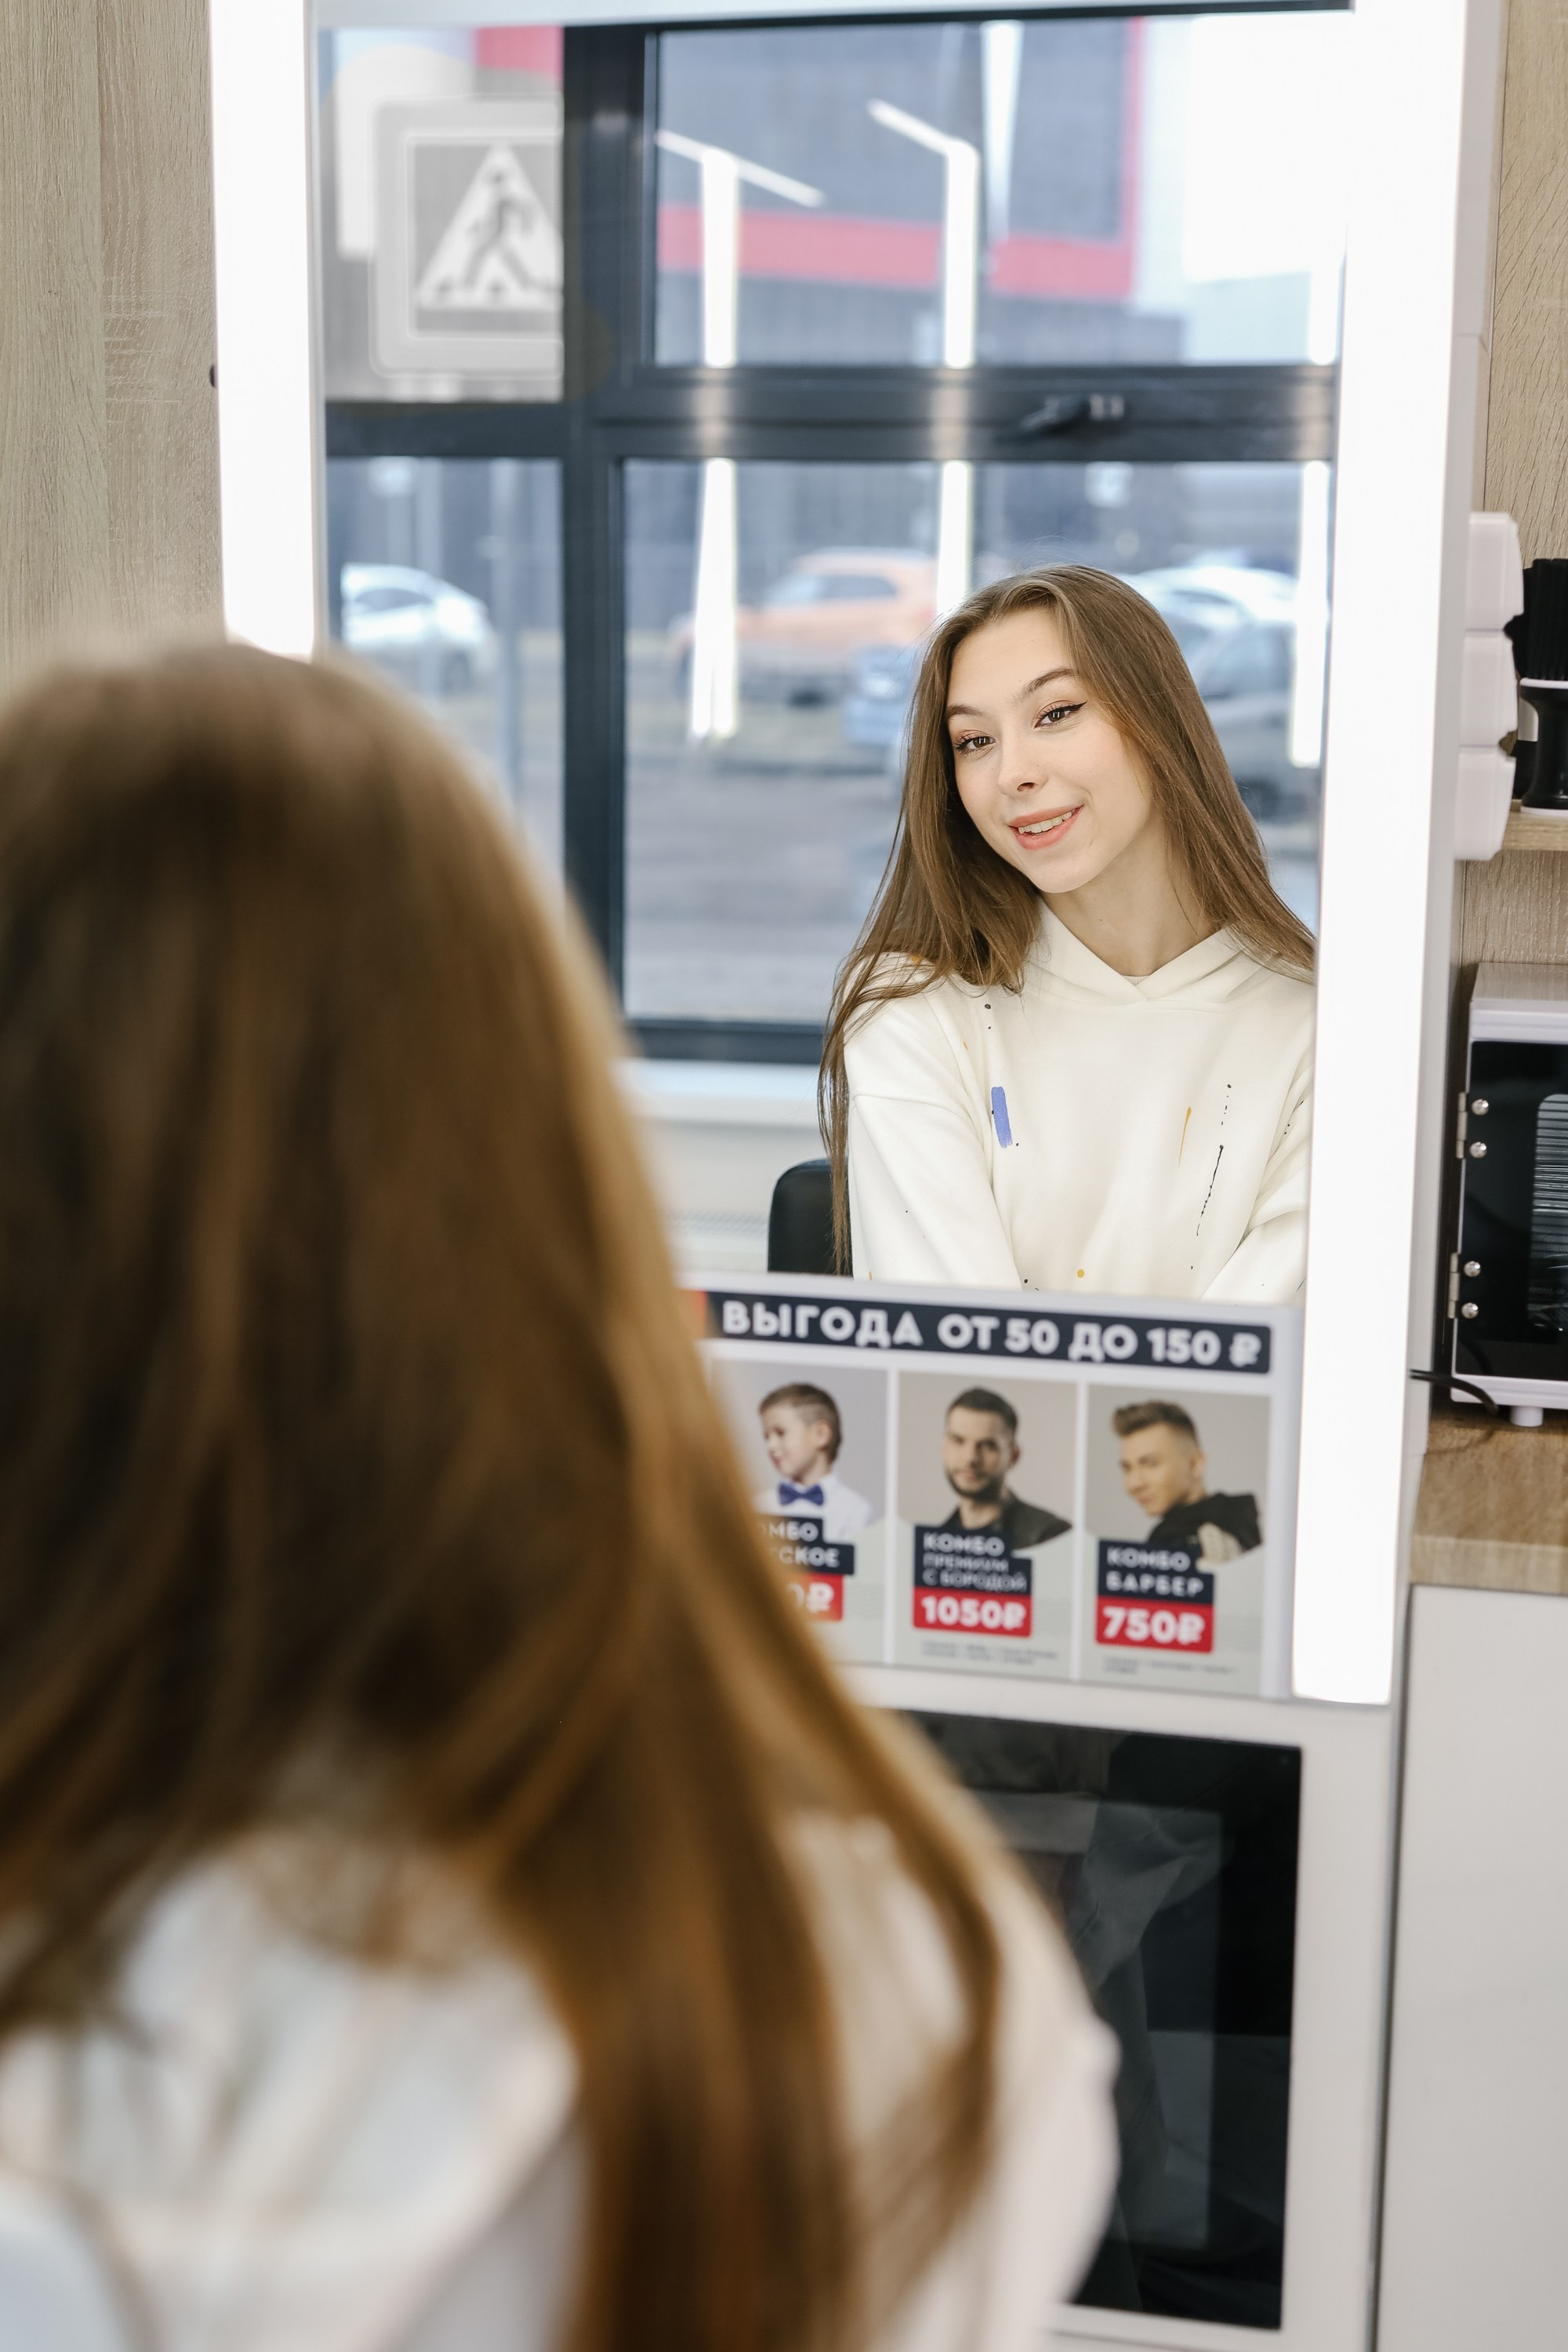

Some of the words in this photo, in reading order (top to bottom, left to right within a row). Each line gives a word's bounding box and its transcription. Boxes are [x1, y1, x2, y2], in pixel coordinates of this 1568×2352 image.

[722, 1300, 924, 1348] ВЫГОДА
[937, 1313, 1000, 1351] ОТ
[1004, 1317, 1060, 1356] 50
[1067, 1321, 1139, 1363] ДО
[1146, 1327, 1221, 1366] 150
[759, 1519, 818, 1542] МБО
[923, 1532, 1005, 1557] КОМБО
[1106, 1546, 1191, 1572] КОМБО
[1105, 1570, 1204, 1597] БАРБЕР
[920, 1595, 1026, 1630] 1050₽
[1102, 1605, 1205, 1645] 750₽
